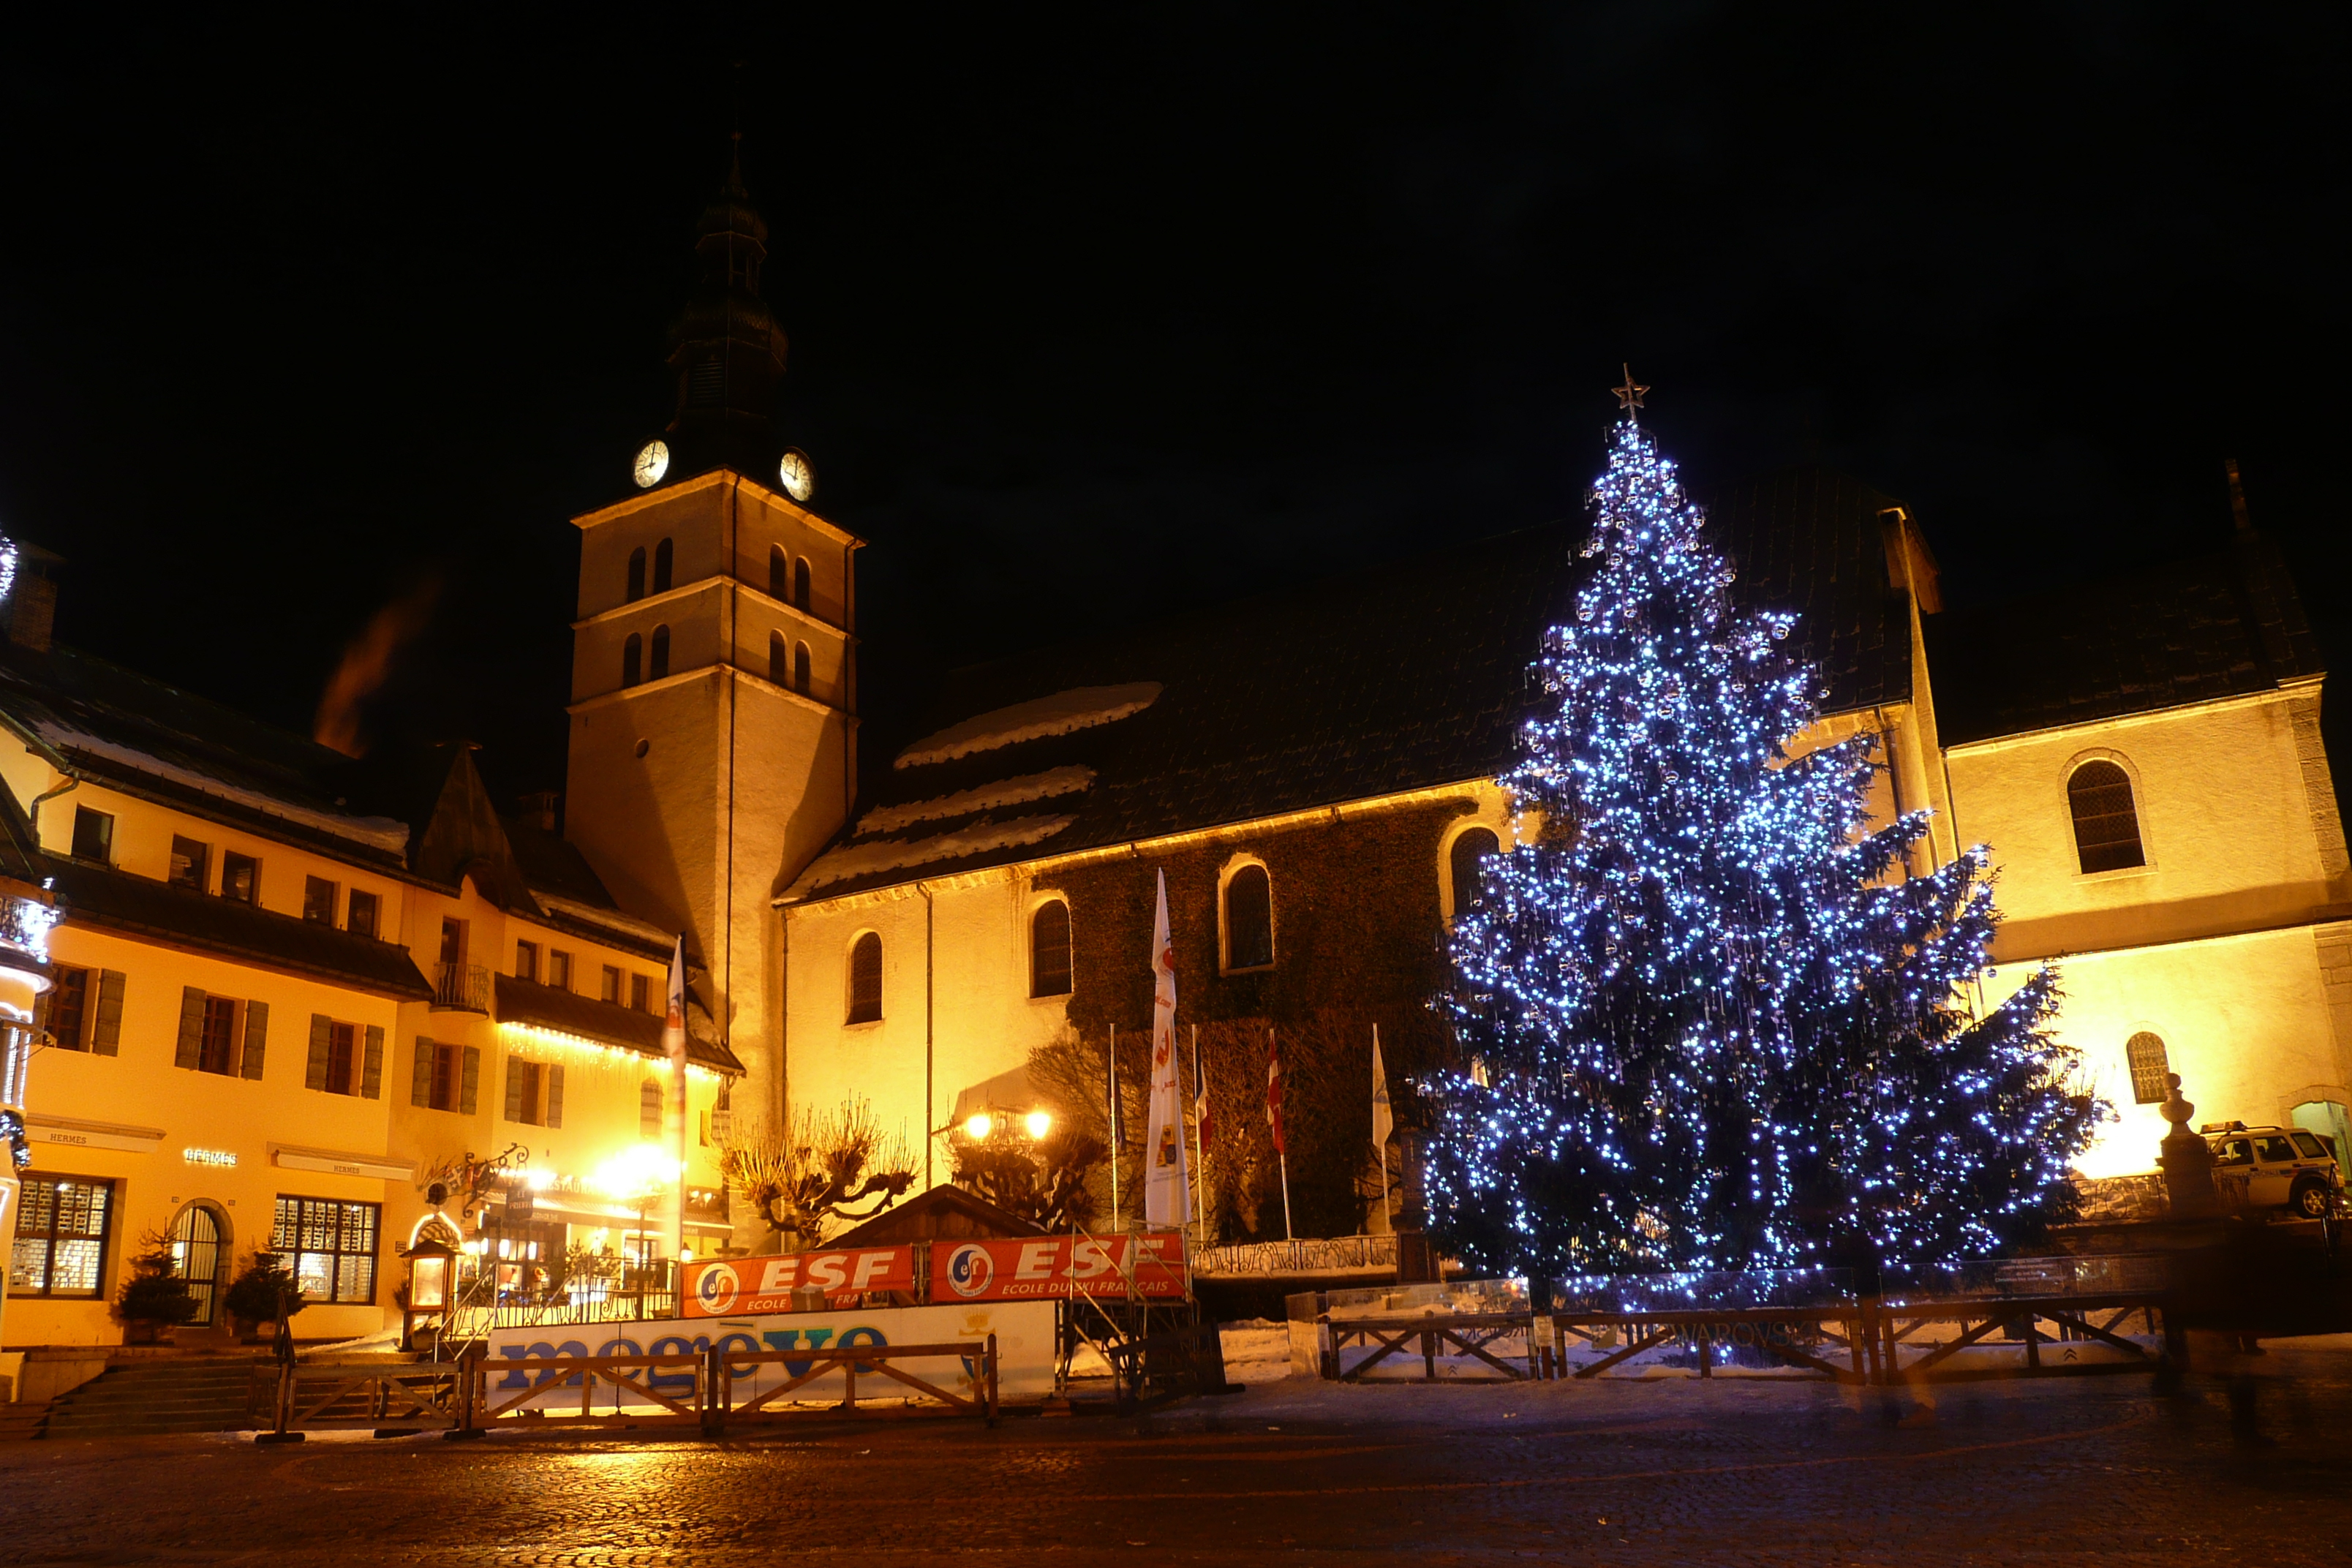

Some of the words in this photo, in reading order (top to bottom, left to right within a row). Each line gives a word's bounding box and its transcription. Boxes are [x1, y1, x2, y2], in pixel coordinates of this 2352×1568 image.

[50, 1134, 87, 1145] HERMES
[186, 1150, 238, 1166] HERMES
[333, 1165, 361, 1175] HERMES
[1014, 1239, 1165, 1280] ESF
[758, 1251, 895, 1297] ESF
[1002, 1284, 1045, 1295] ECOLE
[1049, 1283, 1070, 1293] DU
[1073, 1281, 1095, 1292] SKI
[747, 1299, 787, 1311] ECOLE
